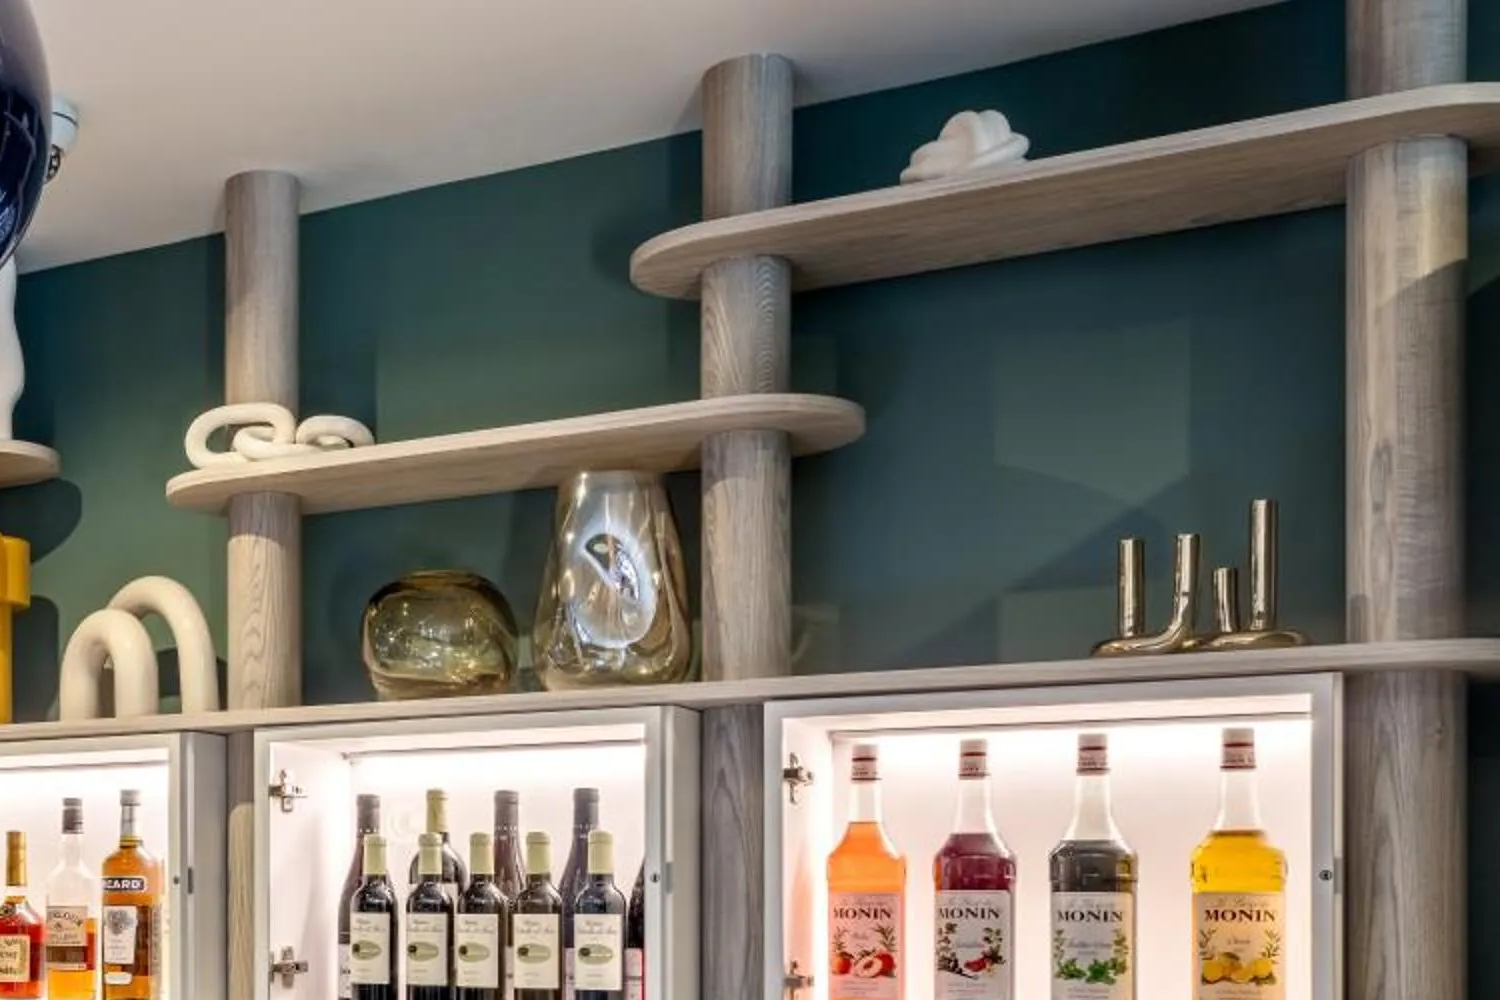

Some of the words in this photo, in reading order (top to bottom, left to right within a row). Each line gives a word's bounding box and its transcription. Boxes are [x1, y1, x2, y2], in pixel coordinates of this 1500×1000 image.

[100, 879, 141, 889] CARD
[833, 907, 892, 919] MONIN
[939, 907, 1000, 919] MONIN
[1057, 911, 1124, 922] MONIN
[1204, 909, 1276, 922] MONIN
